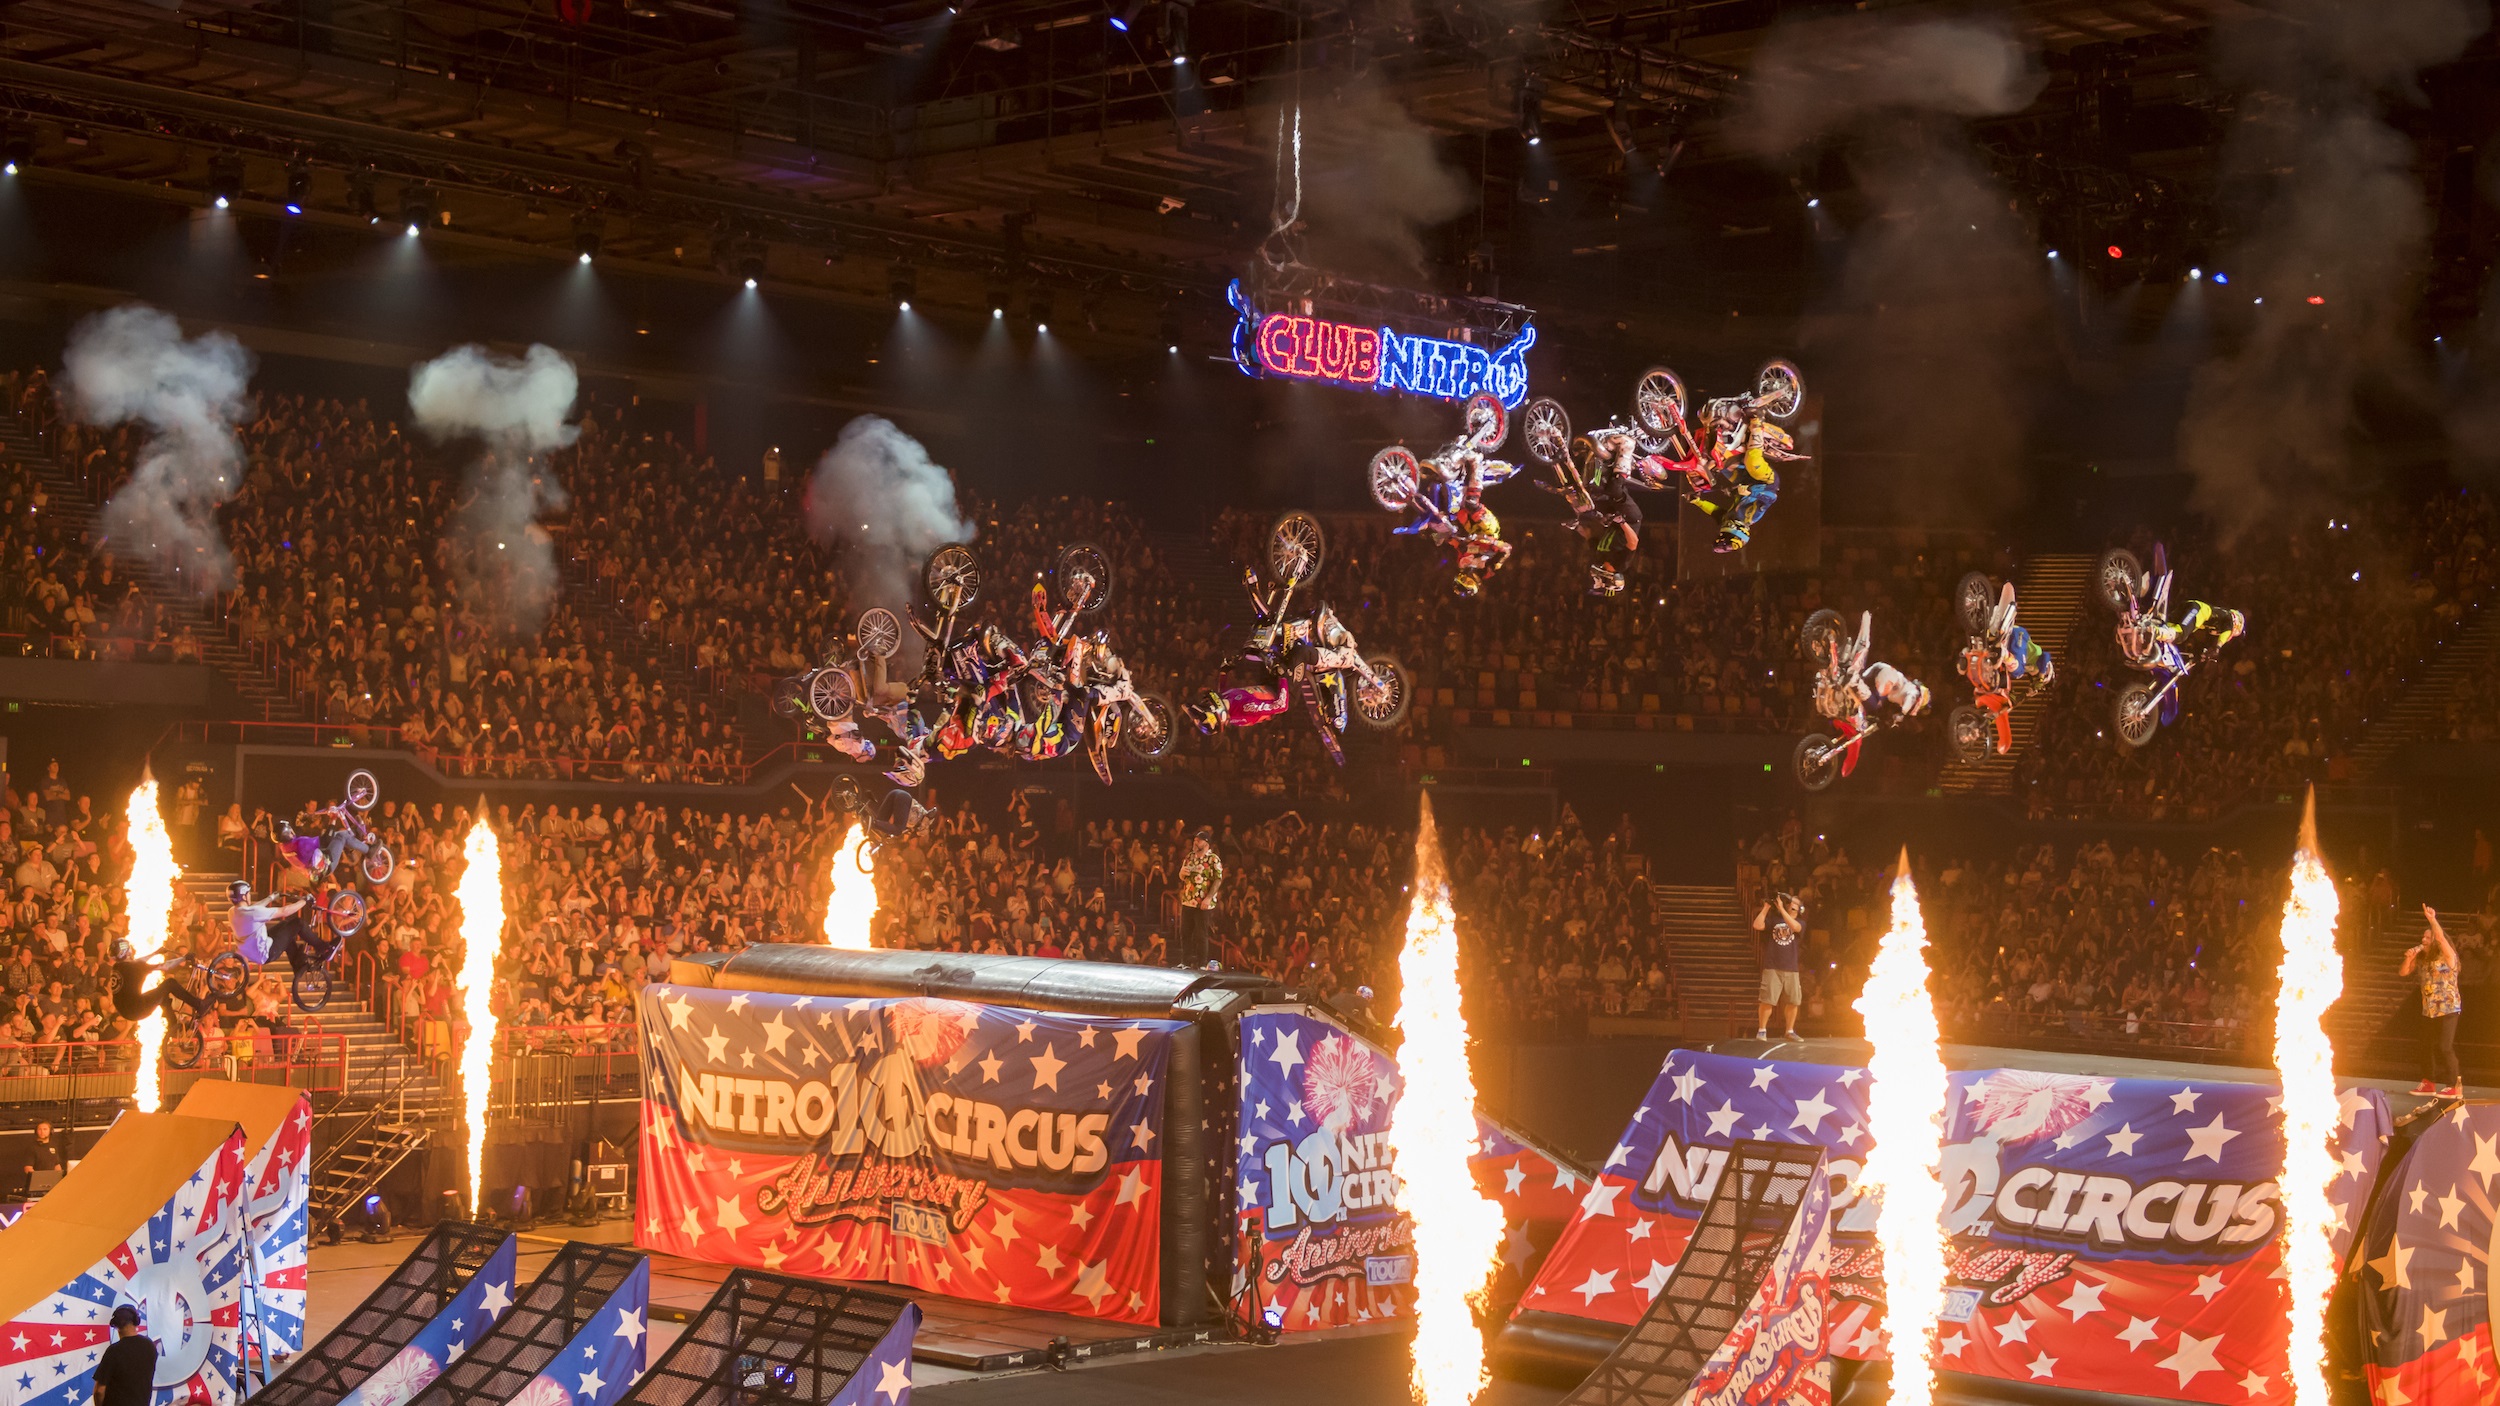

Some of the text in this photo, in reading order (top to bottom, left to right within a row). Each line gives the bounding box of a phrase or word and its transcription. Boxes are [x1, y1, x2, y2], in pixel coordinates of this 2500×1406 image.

[1259, 313, 1381, 383] CLUB
[679, 1064, 836, 1138] NITRO
[924, 1091, 1112, 1176] CIRCUS
[1340, 1130, 1394, 1174] NIT
[758, 1152, 988, 1231] Anniversary
[895, 1206, 946, 1241] TOUR
[1342, 1168, 1401, 1211] CIR
[1995, 1167, 2281, 1244] CIRCUS
[1770, 1283, 1823, 1351] CIRCUS
[1757, 1364, 1786, 1400] LIVE
